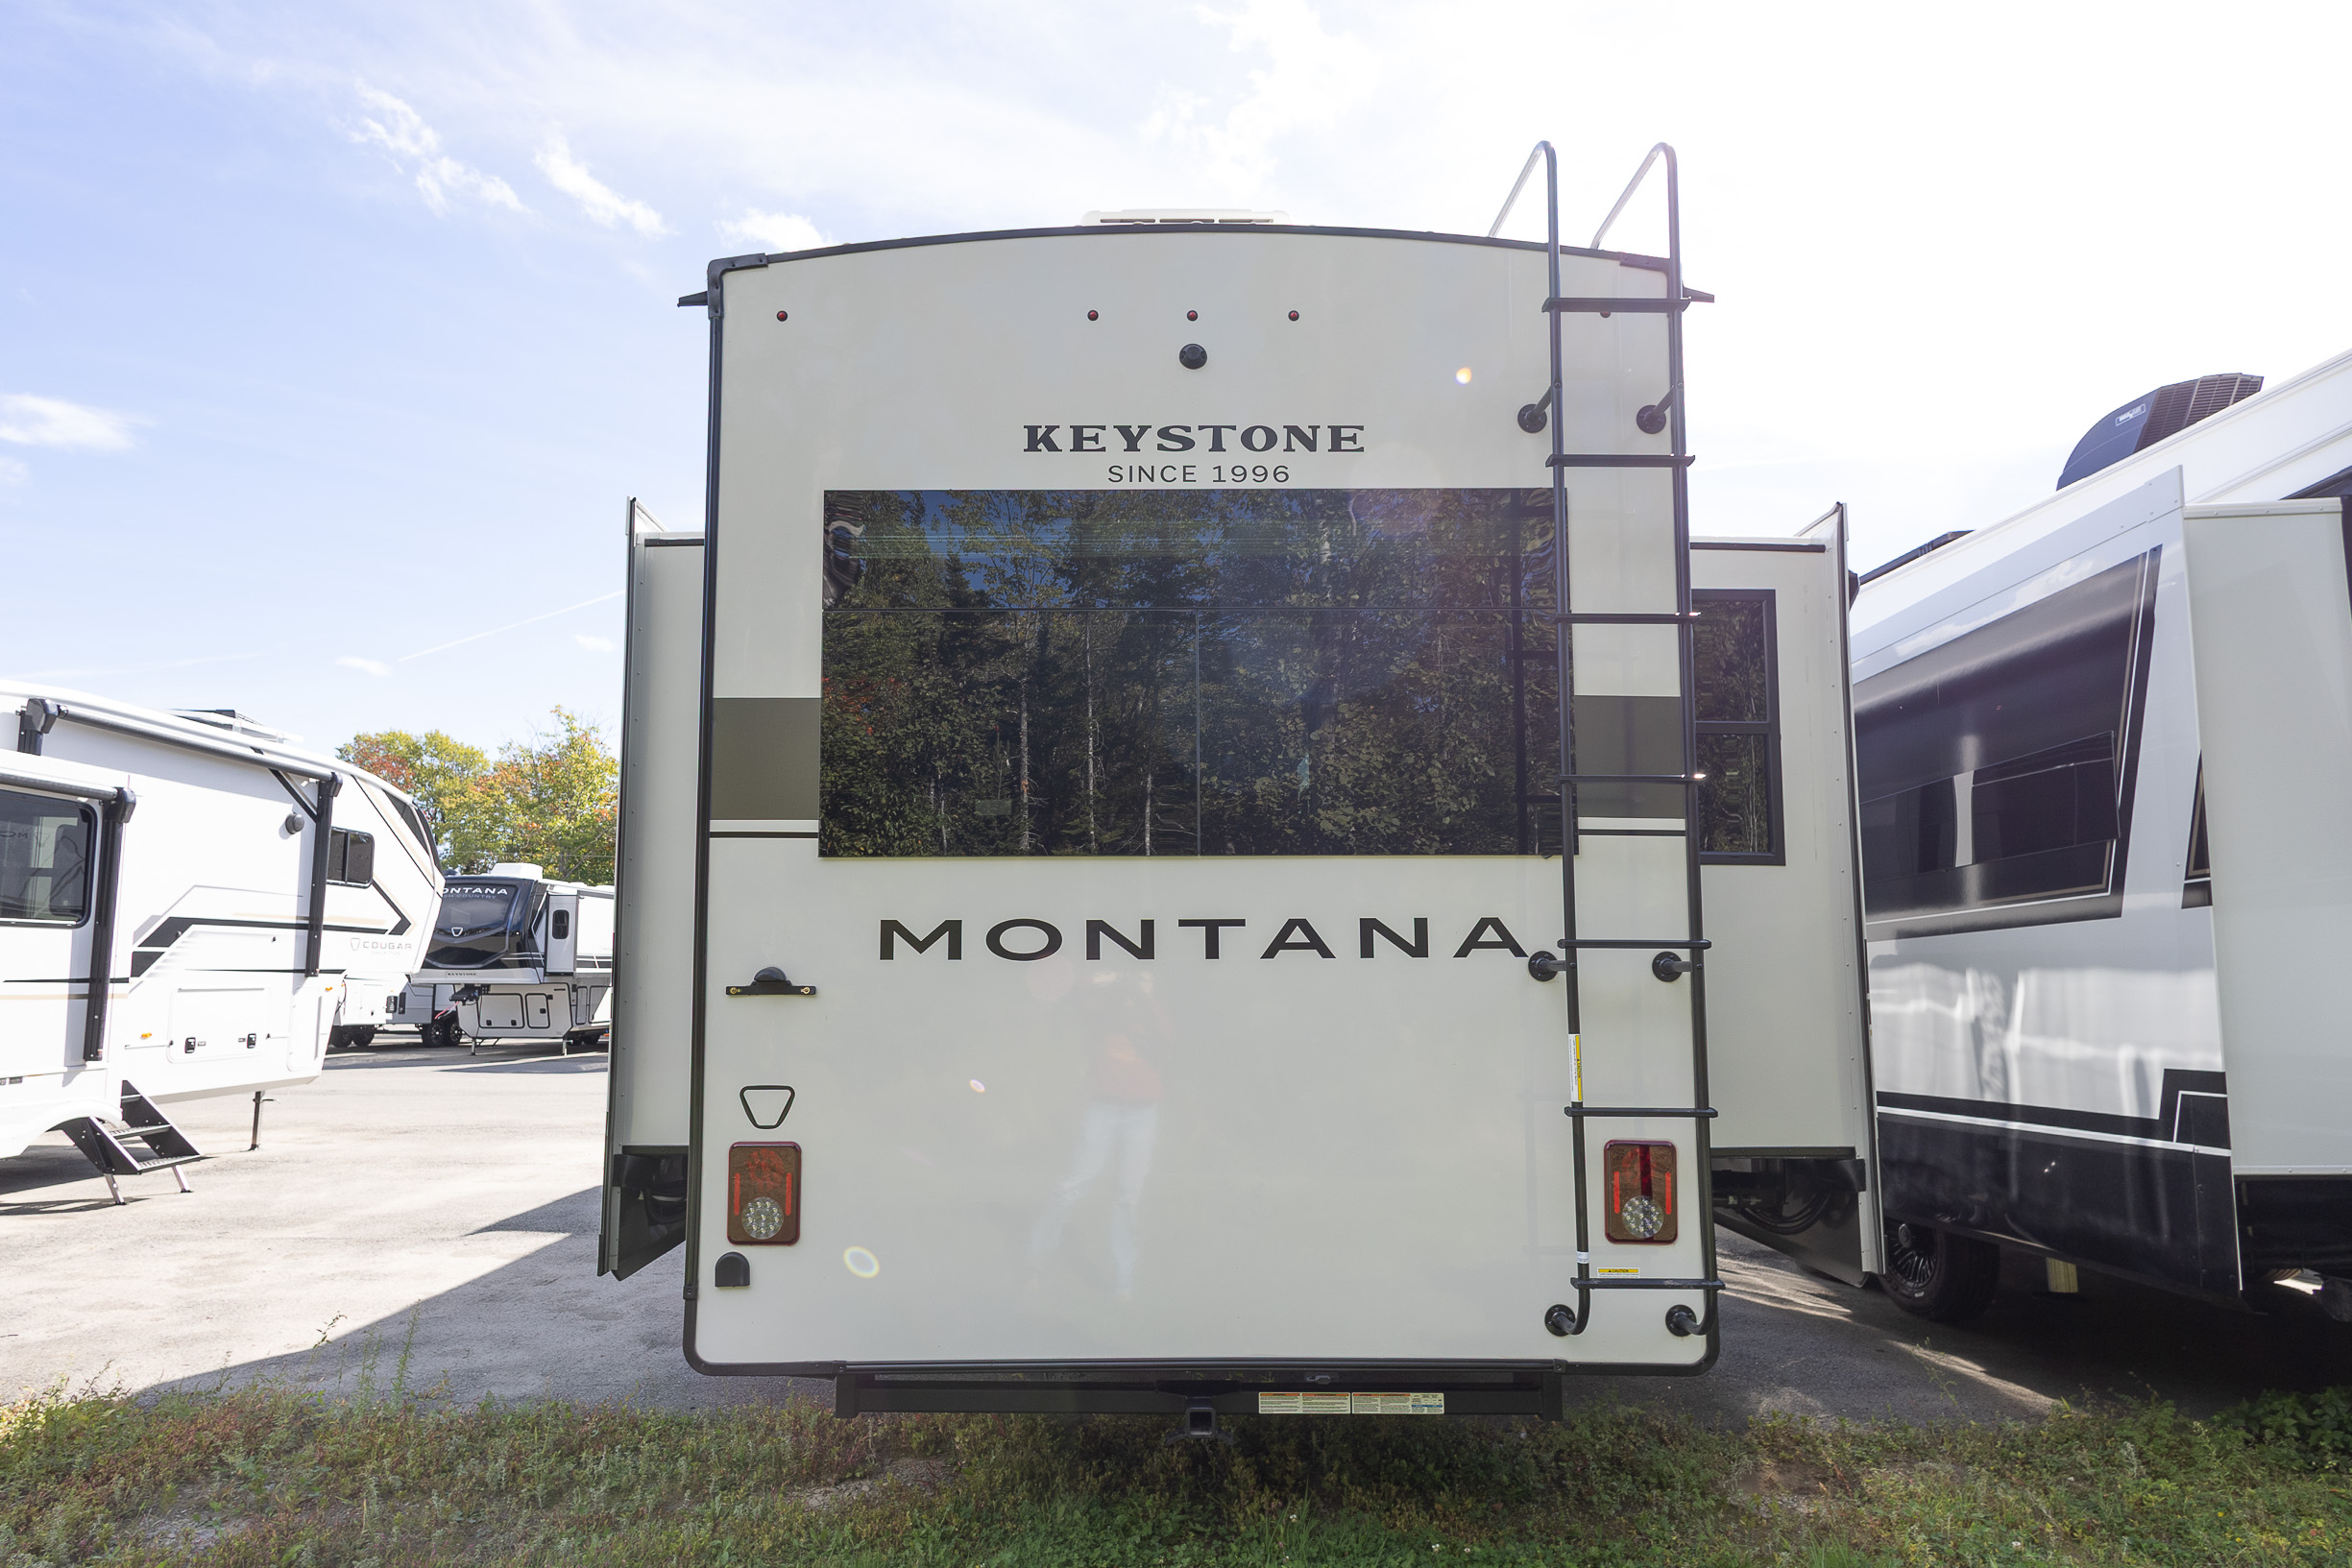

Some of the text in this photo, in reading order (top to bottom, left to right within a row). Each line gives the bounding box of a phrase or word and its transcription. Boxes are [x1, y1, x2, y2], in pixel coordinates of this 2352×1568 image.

[1023, 424, 1365, 453] KEYSTONE
[1107, 465, 1290, 483] SINCE 1996
[362, 941, 412, 950] COUGAR
[879, 916, 1529, 962] MONTANA
